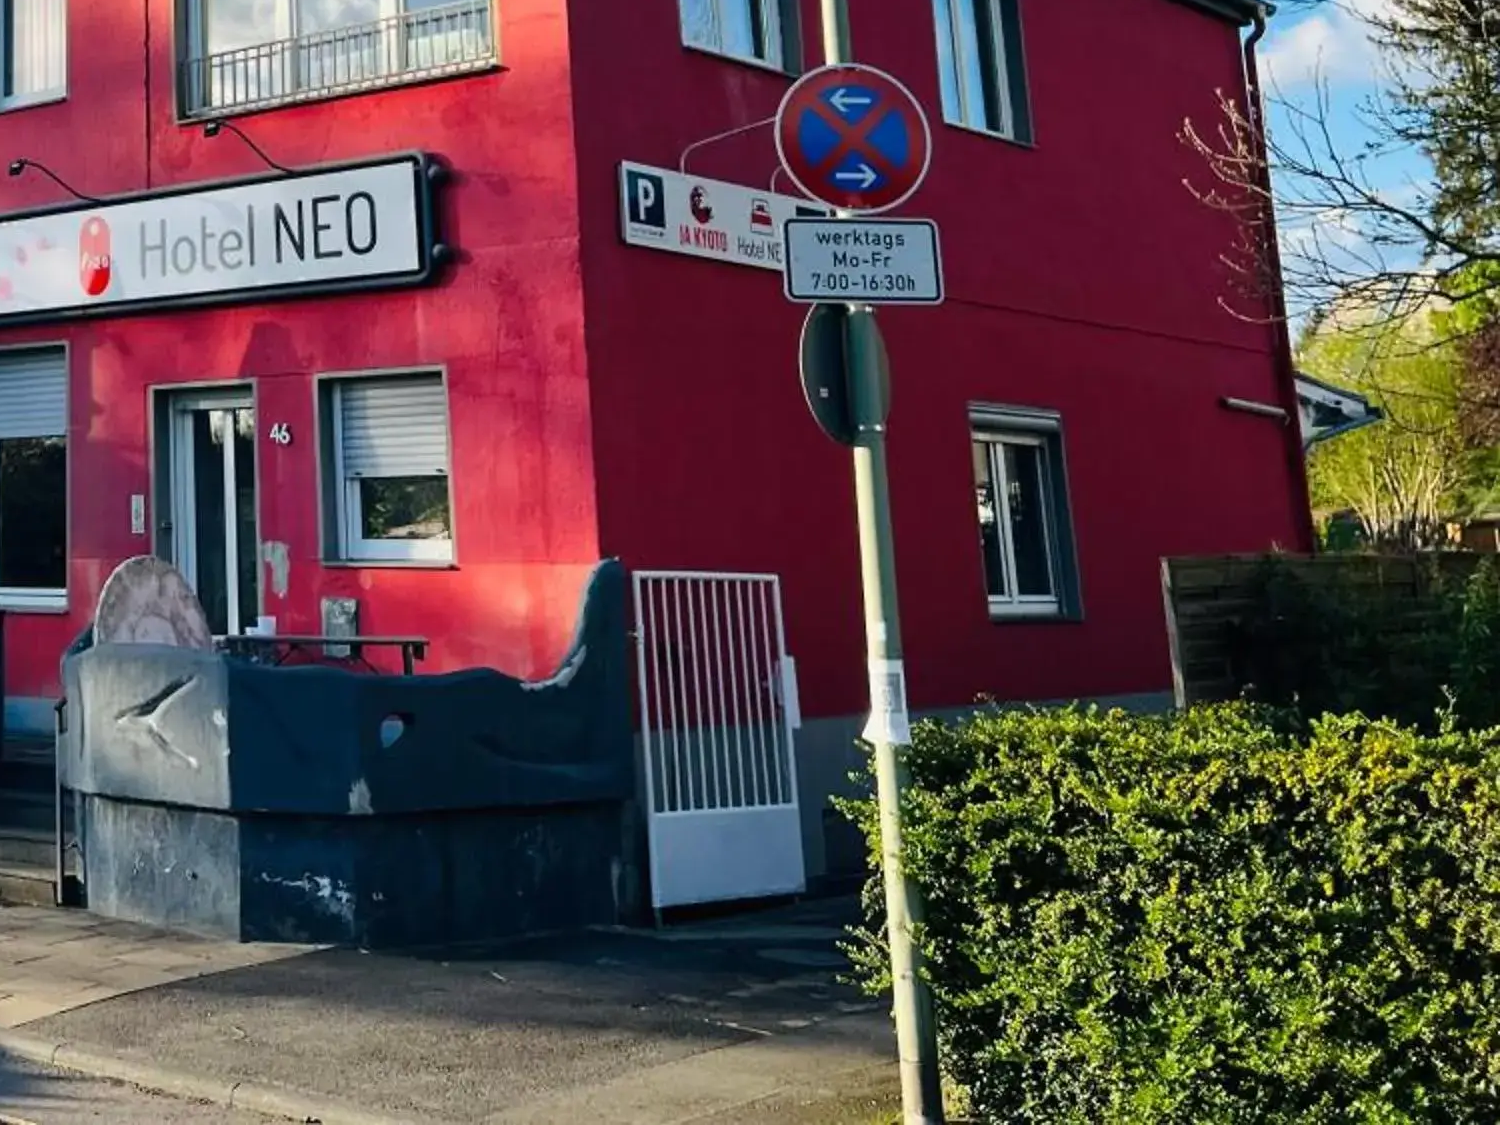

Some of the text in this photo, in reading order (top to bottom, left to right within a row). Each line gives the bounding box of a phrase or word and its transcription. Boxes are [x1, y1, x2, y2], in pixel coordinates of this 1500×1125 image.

[637, 178, 655, 221] P
[139, 190, 378, 279] Hotel NEO
[679, 223, 691, 246] JA
[693, 226, 729, 253] KYOTO
[816, 228, 905, 250] werktags
[737, 235, 783, 264] Hotel NE
[833, 250, 892, 268] Mo-Fr
[269, 422, 291, 445] 46
